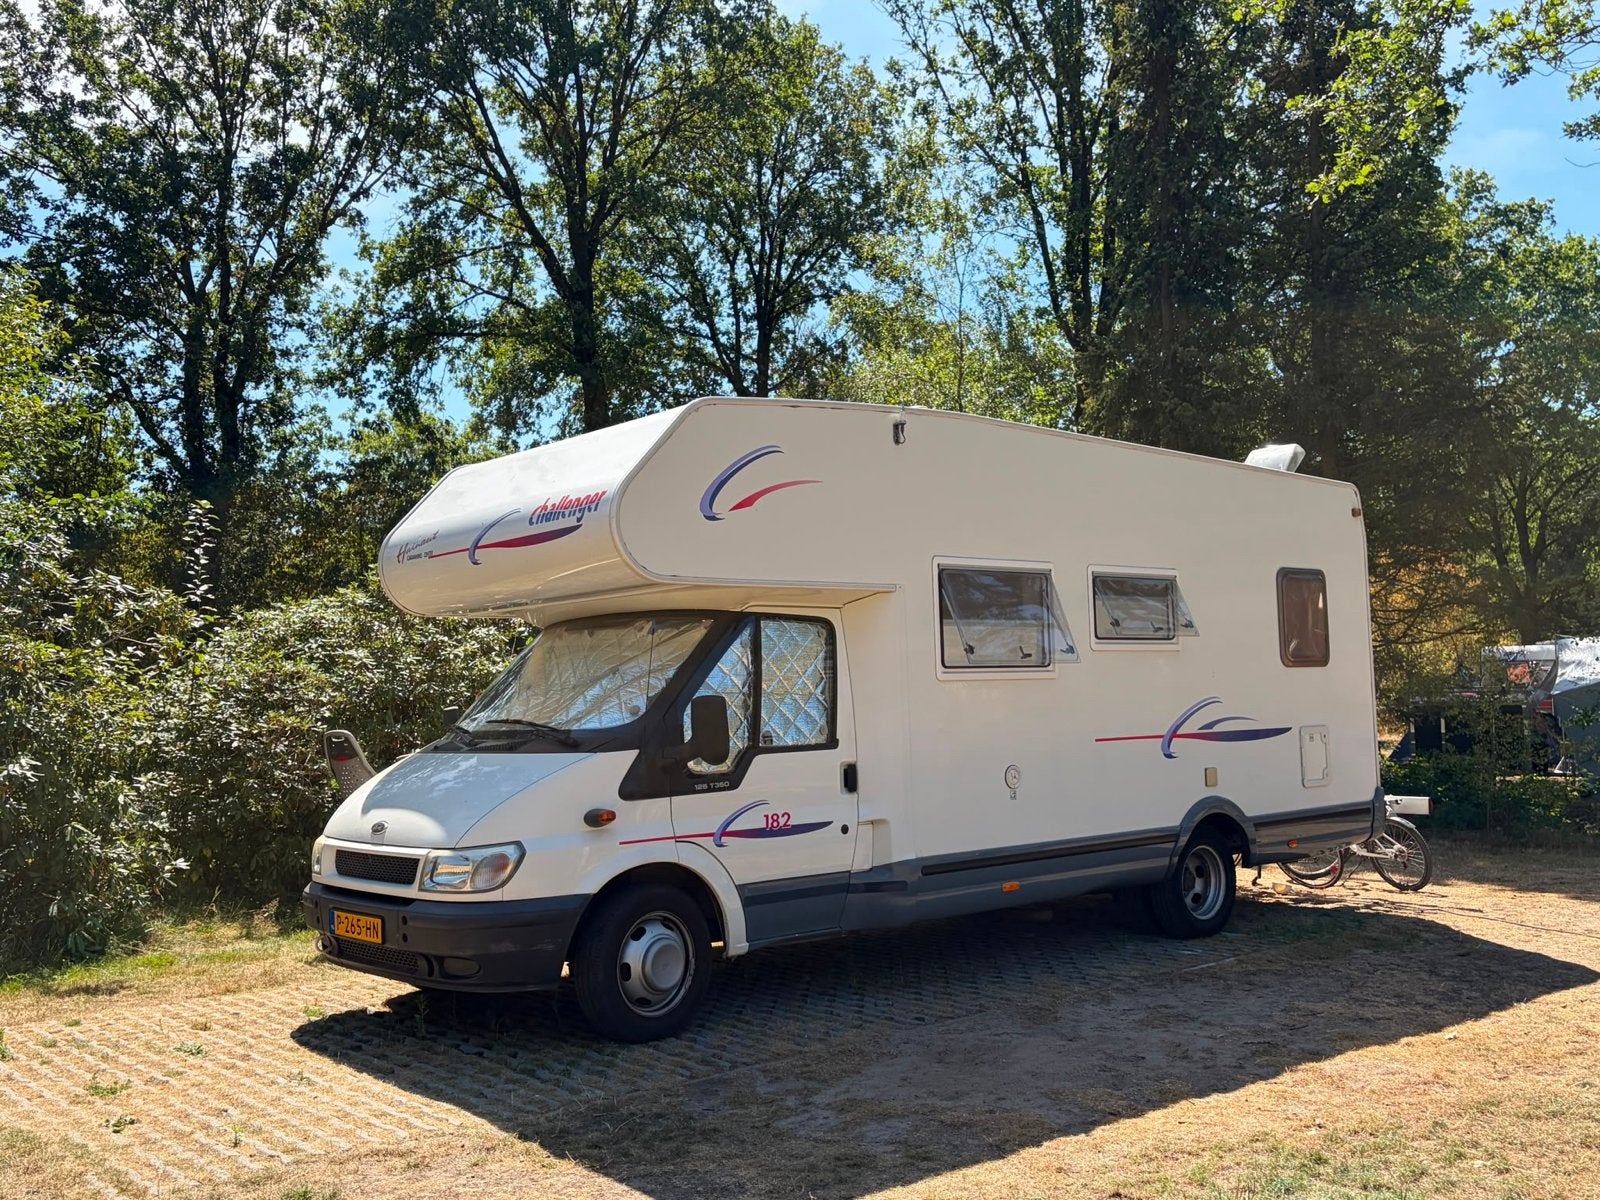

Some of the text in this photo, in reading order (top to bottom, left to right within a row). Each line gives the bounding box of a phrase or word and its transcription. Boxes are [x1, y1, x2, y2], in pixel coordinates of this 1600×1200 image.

[710, 781, 730, 789] T350
[763, 811, 791, 830] 182
[336, 915, 379, 939] P-265-HN
